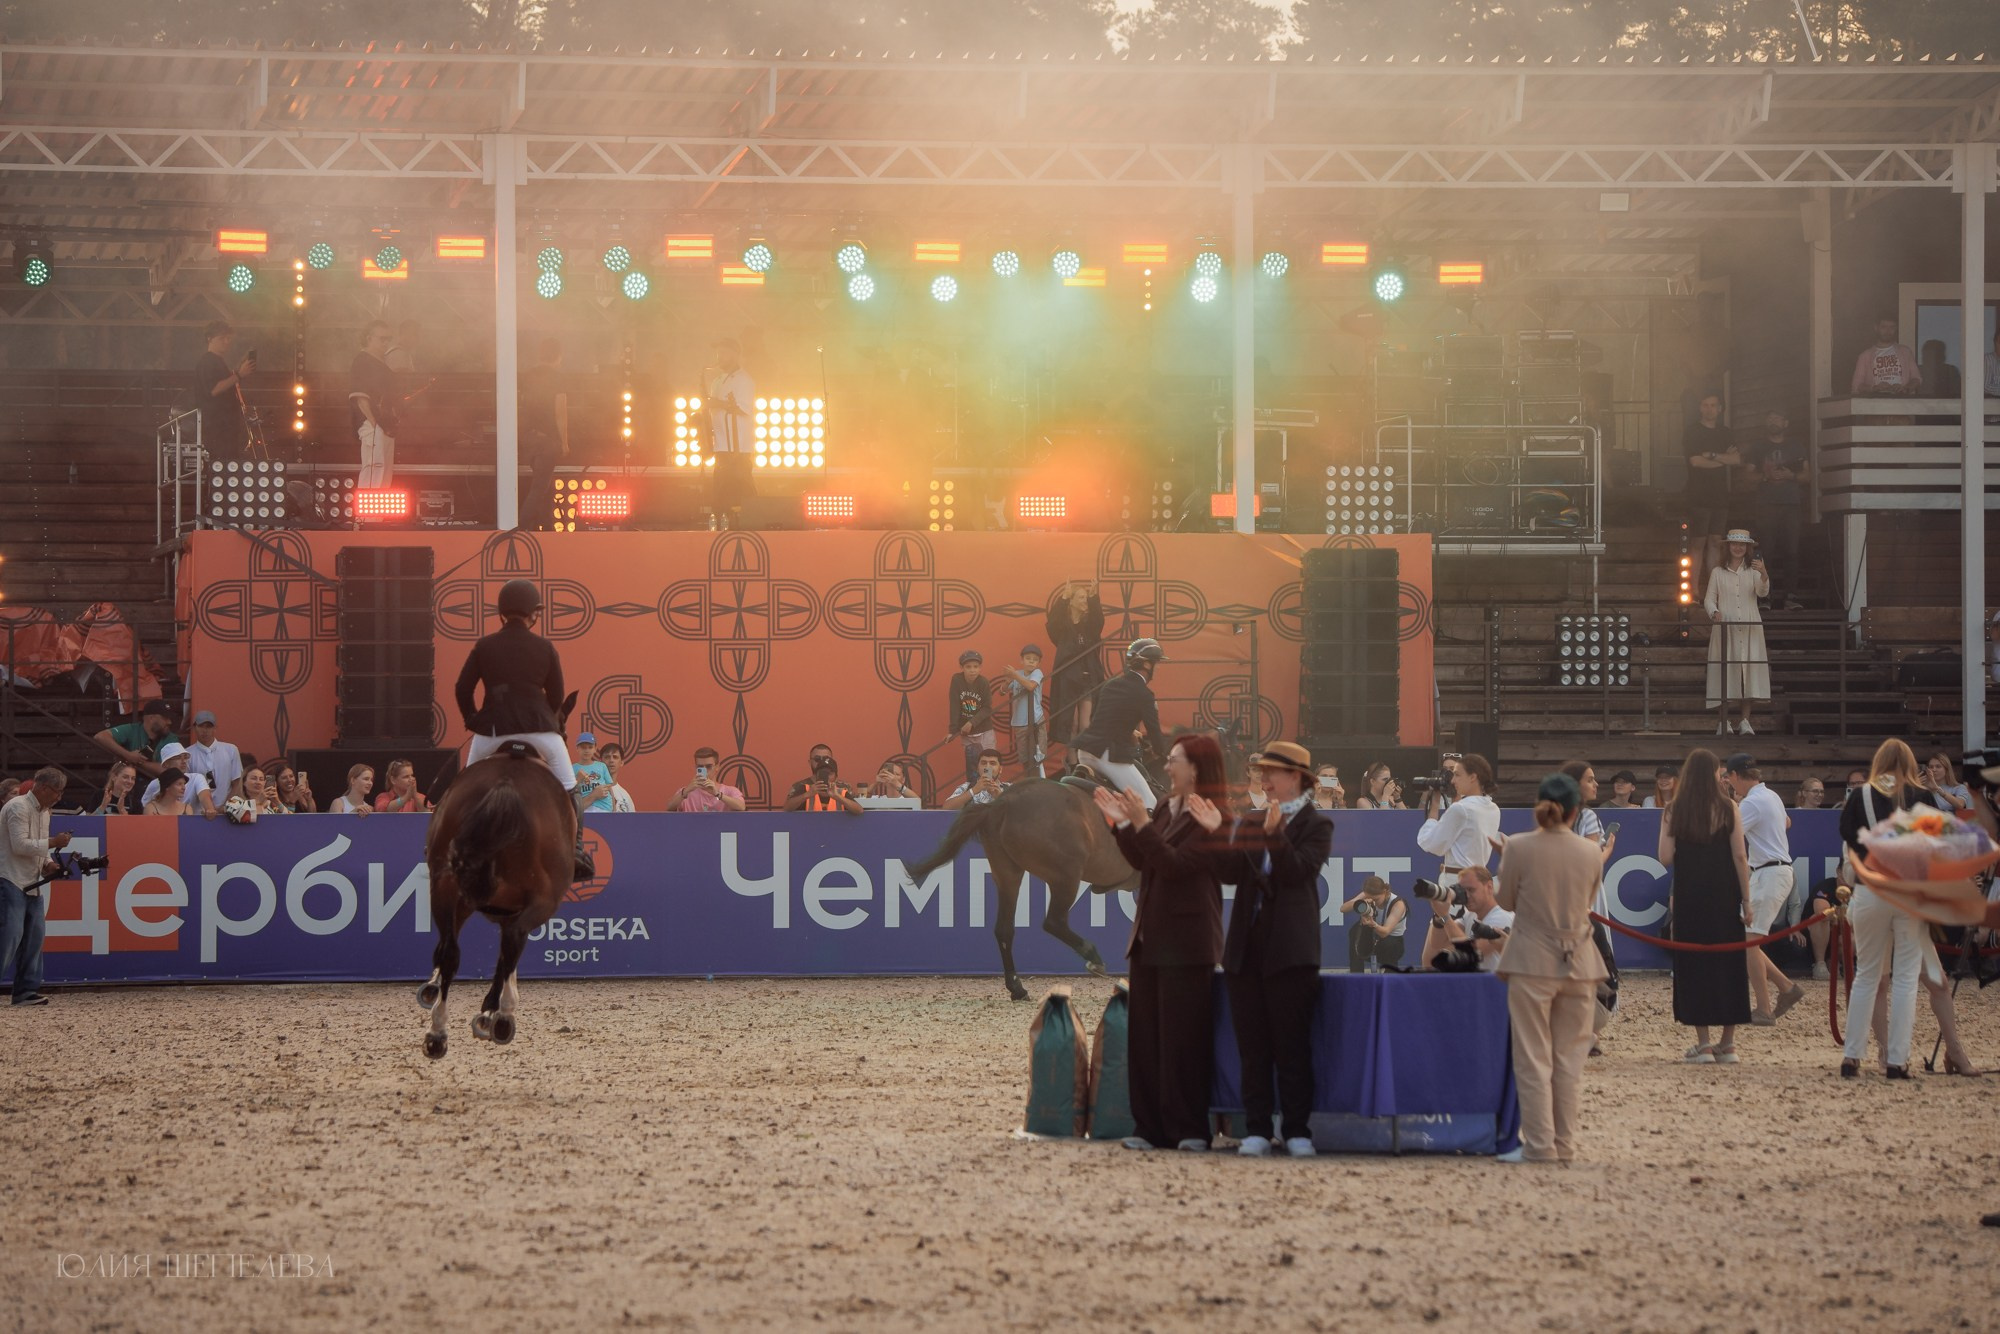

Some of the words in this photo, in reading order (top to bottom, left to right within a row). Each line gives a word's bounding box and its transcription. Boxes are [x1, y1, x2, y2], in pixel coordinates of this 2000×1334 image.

[41, 833, 432, 963] Дерби
[721, 831, 1411, 930] Чемпат
[526, 917, 650, 942] ORSEKA
[544, 946, 600, 966] sport
